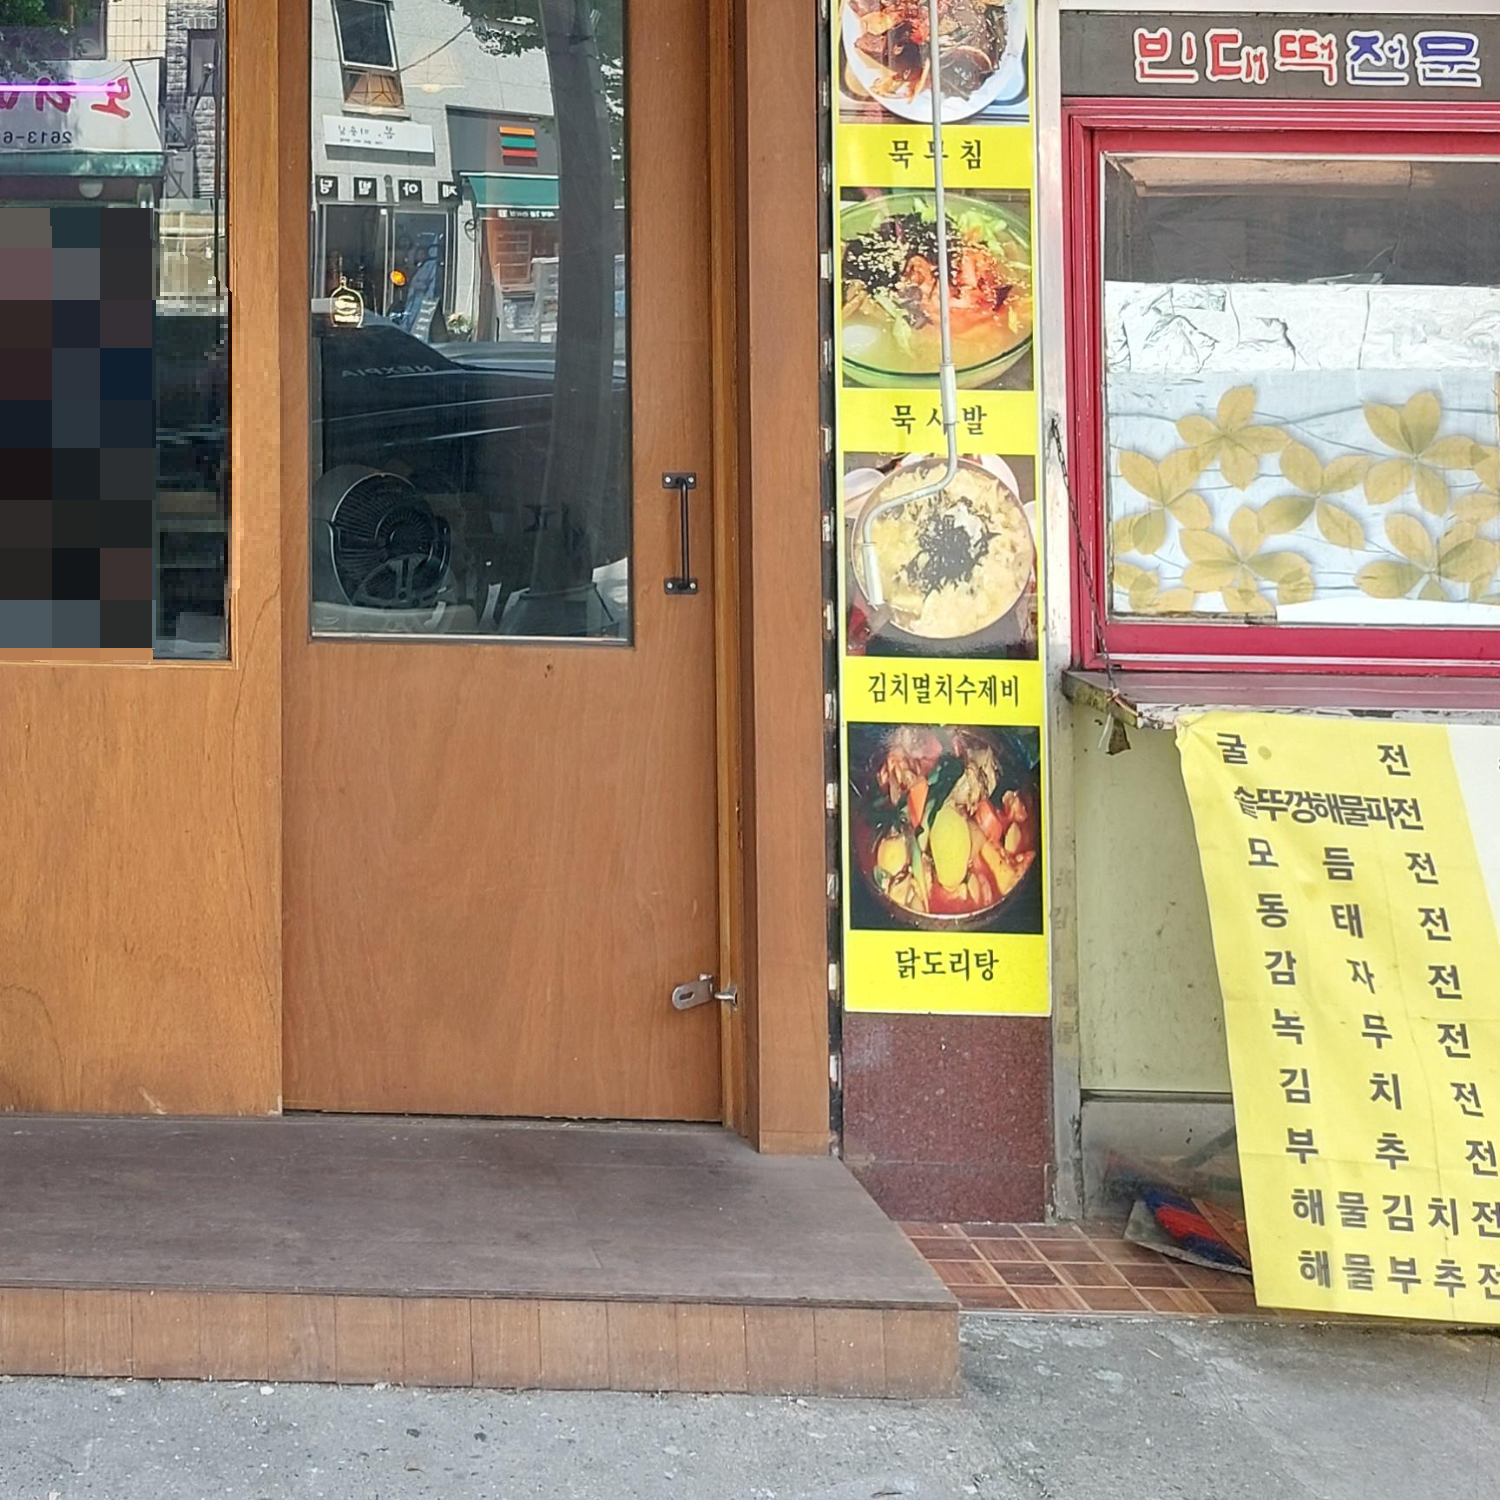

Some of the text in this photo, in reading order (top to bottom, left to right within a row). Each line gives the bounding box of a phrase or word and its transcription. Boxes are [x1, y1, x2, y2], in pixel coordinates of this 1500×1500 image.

[866, 671, 1021, 708] 김치멸치수제비
[1233, 784, 1426, 832] 솥뚜껑해물파전
[895, 946, 1000, 983] 닭도리탕
